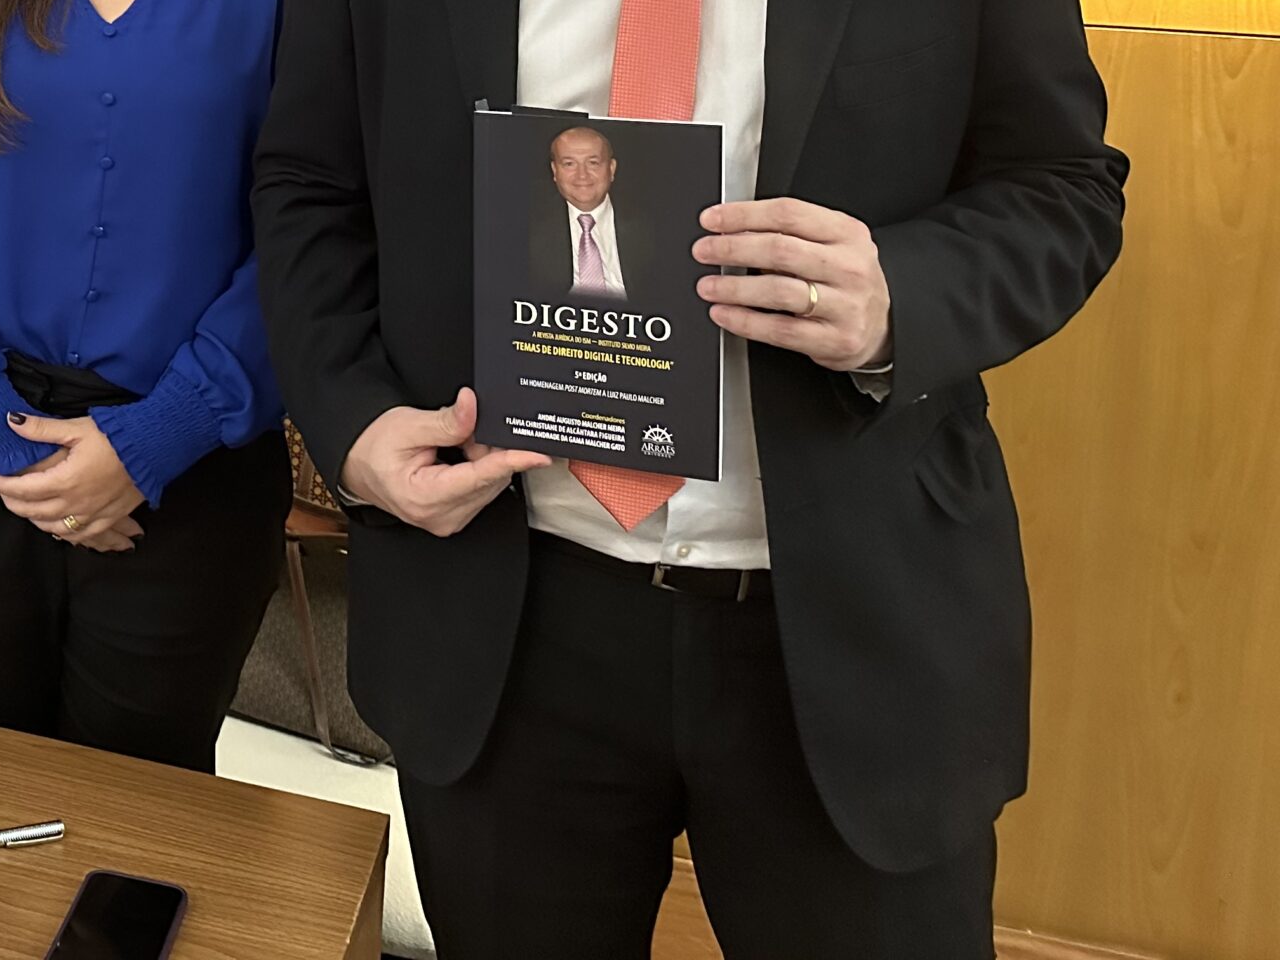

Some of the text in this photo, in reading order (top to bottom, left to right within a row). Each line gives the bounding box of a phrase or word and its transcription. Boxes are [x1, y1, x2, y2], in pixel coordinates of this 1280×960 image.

[513, 300, 672, 342] DIGESTO
[541, 344, 552, 355] DE
[552, 346, 583, 359] DIREITO
[584, 350, 615, 363] DIGITAL
[615, 354, 621, 364] E
[582, 371, 607, 383] EDIÇÃO
[519, 377, 529, 386] EM
[528, 378, 565, 391] HOMENAGEM
[564, 384, 579, 393] POST
[619, 391, 638, 402] PAULO
[637, 395, 665, 406] MALCHER
[537, 413, 557, 423] ANDRÉ
[556, 416, 582, 427] AUGUSTO
[581, 411, 626, 425] Coordenadores
[558, 425, 566, 433] DE
[641, 442, 676, 455] ARRAES
